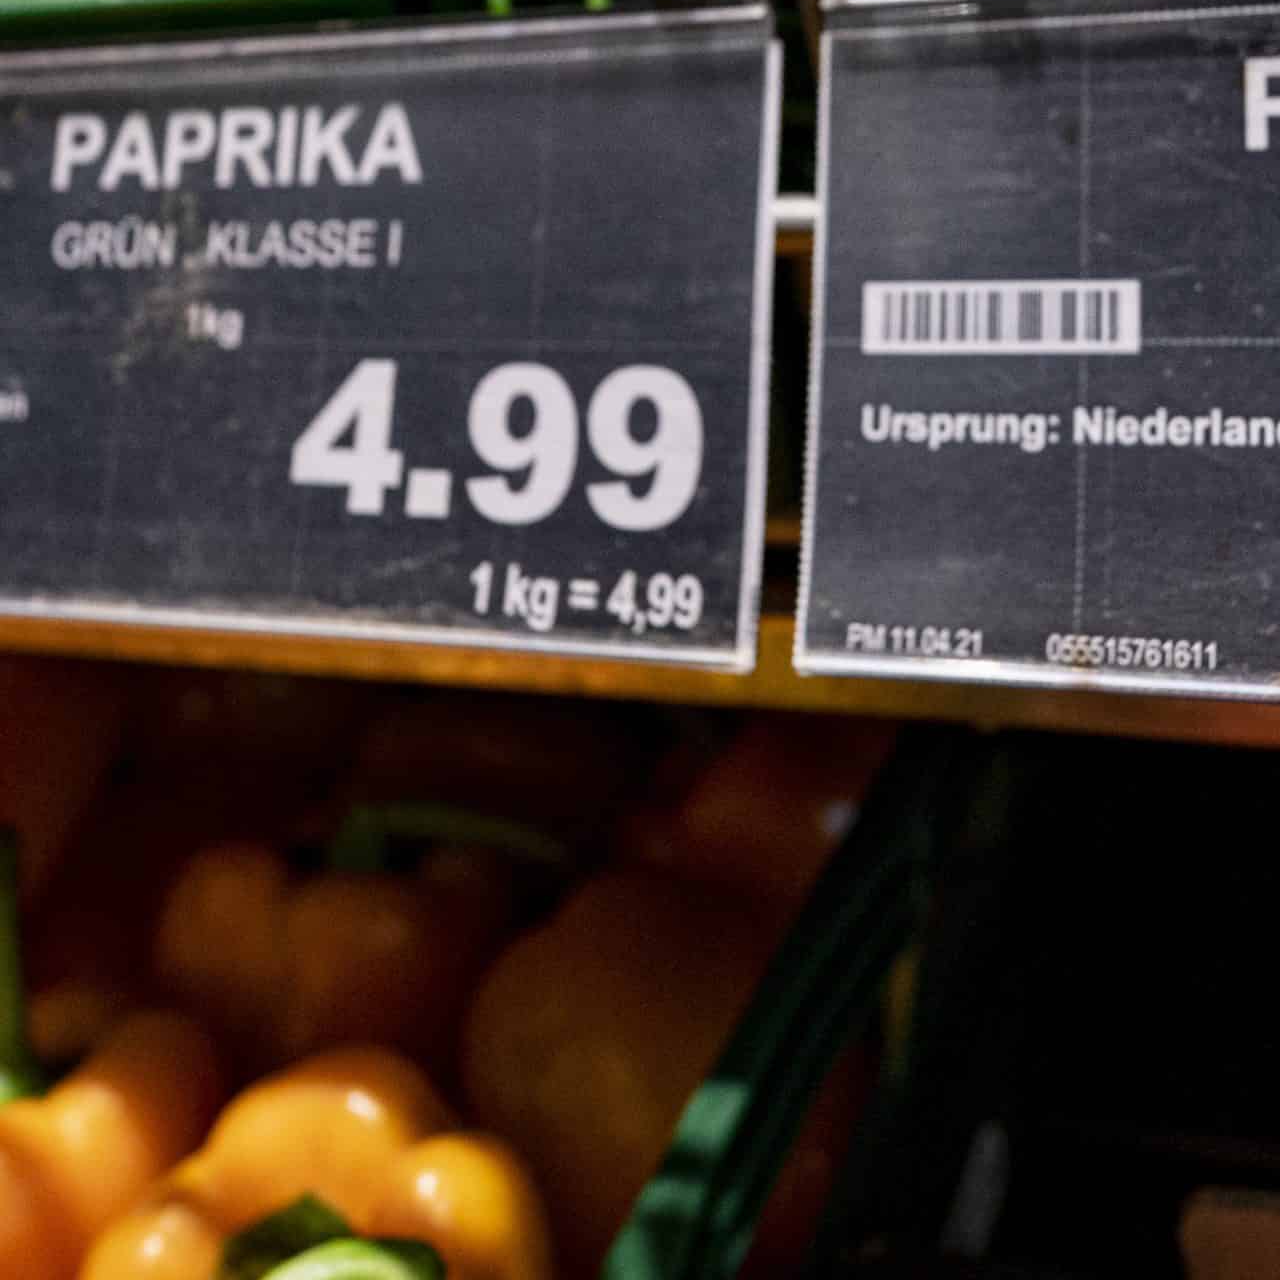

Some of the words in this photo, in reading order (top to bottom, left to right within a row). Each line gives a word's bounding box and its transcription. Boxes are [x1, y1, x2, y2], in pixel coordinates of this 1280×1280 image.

[51, 104, 423, 191] PAPRIKA
[205, 220, 376, 268] KLASSE
[387, 219, 403, 266] I
[290, 357, 704, 532] 4.99
[861, 403, 1061, 453] Ursprung:
[470, 561, 494, 614] 1
[504, 565, 559, 631] kg
[607, 570, 703, 634] 4,99
